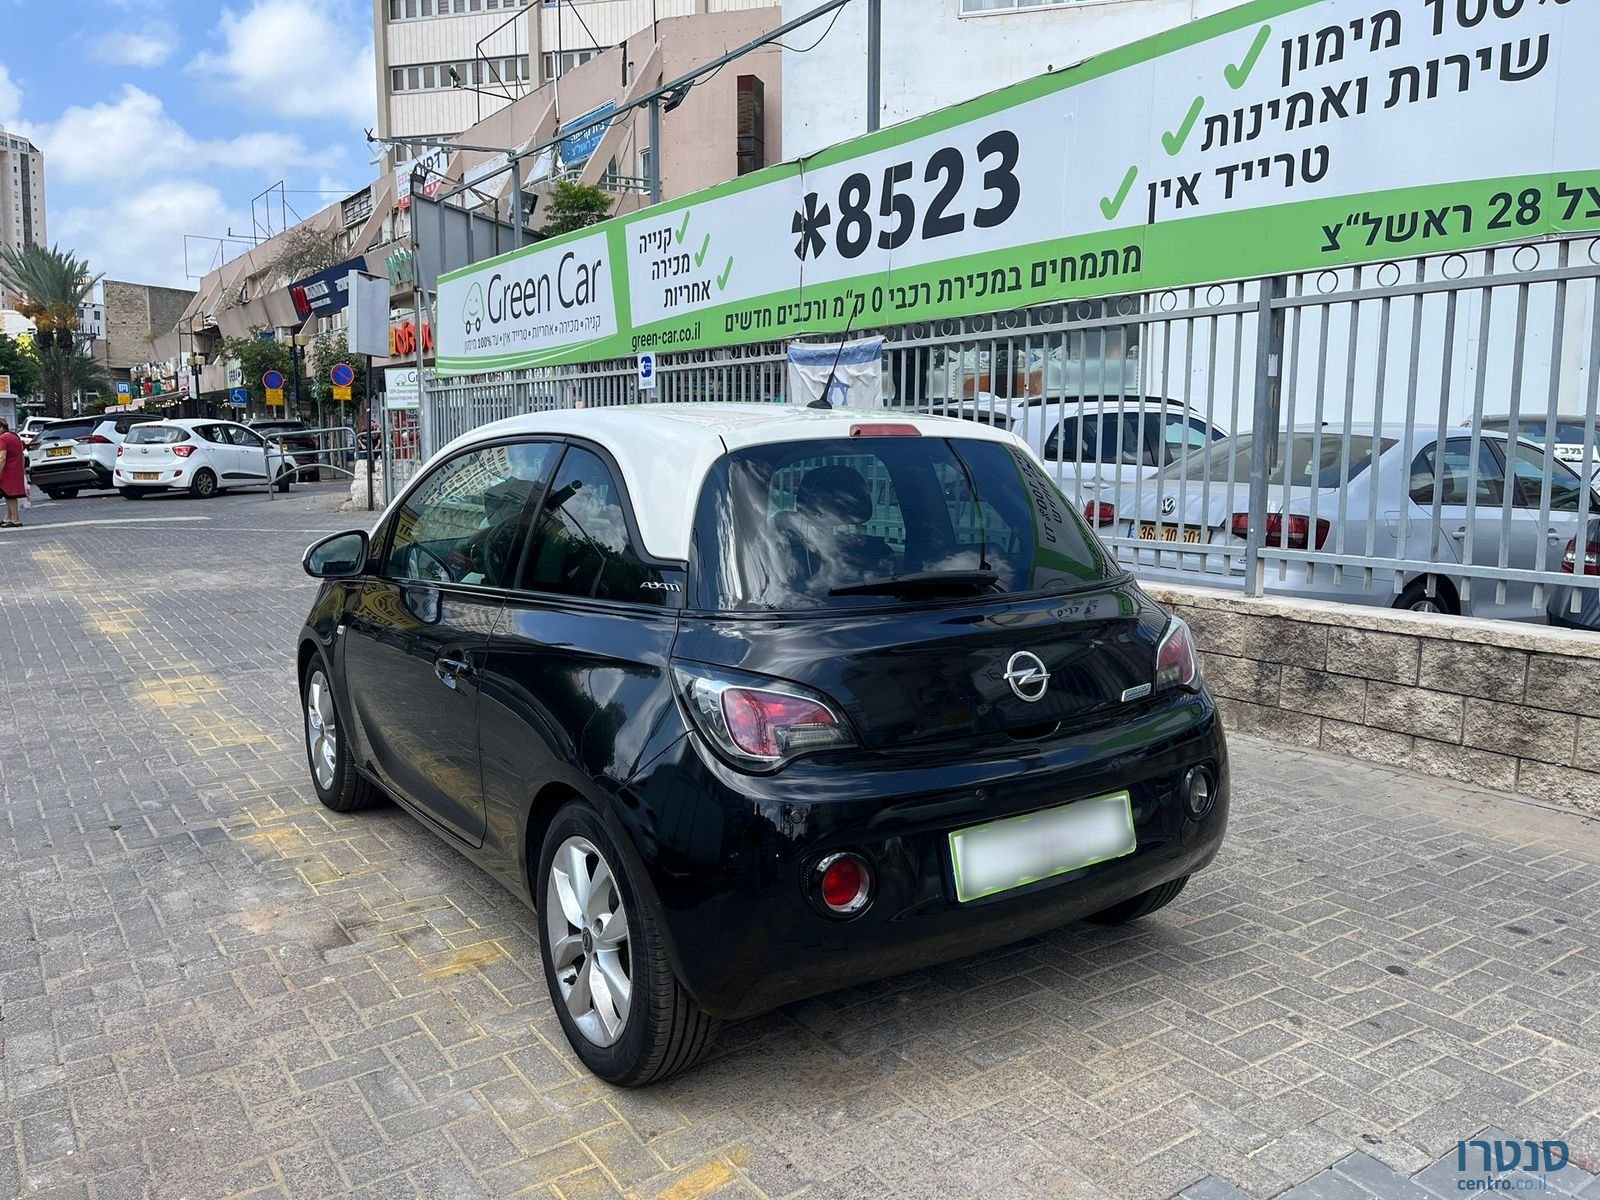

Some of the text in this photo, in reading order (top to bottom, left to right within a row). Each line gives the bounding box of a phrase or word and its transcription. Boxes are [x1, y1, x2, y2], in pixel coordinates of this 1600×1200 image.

[1281, 9, 1401, 88] מימון
[1200, 33, 1550, 152] שירות ואמינות
[1148, 145, 1330, 225] טרייד אין
[1487, 188, 1541, 231] 28
[639, 227, 672, 254] קנייה
[1321, 205, 1473, 252] ראשל"צ
[652, 253, 690, 280] מכירה
[1031, 245, 1142, 288] מתמחים
[487, 251, 602, 324] Green Car
[663, 279, 711, 308] אחריות
[872, 286, 882, 313] 0
[889, 283, 931, 310] רכבי
[937, 266, 1022, 304] במכירת
[559, 319, 579, 334] מכירה
[584, 315, 601, 332] קניה
[725, 306, 772, 333] חדשים
[777, 298, 827, 326] ורכבים
[532, 323, 554, 339] אחריות
[631, 321, 701, 351] green-car.co.il
